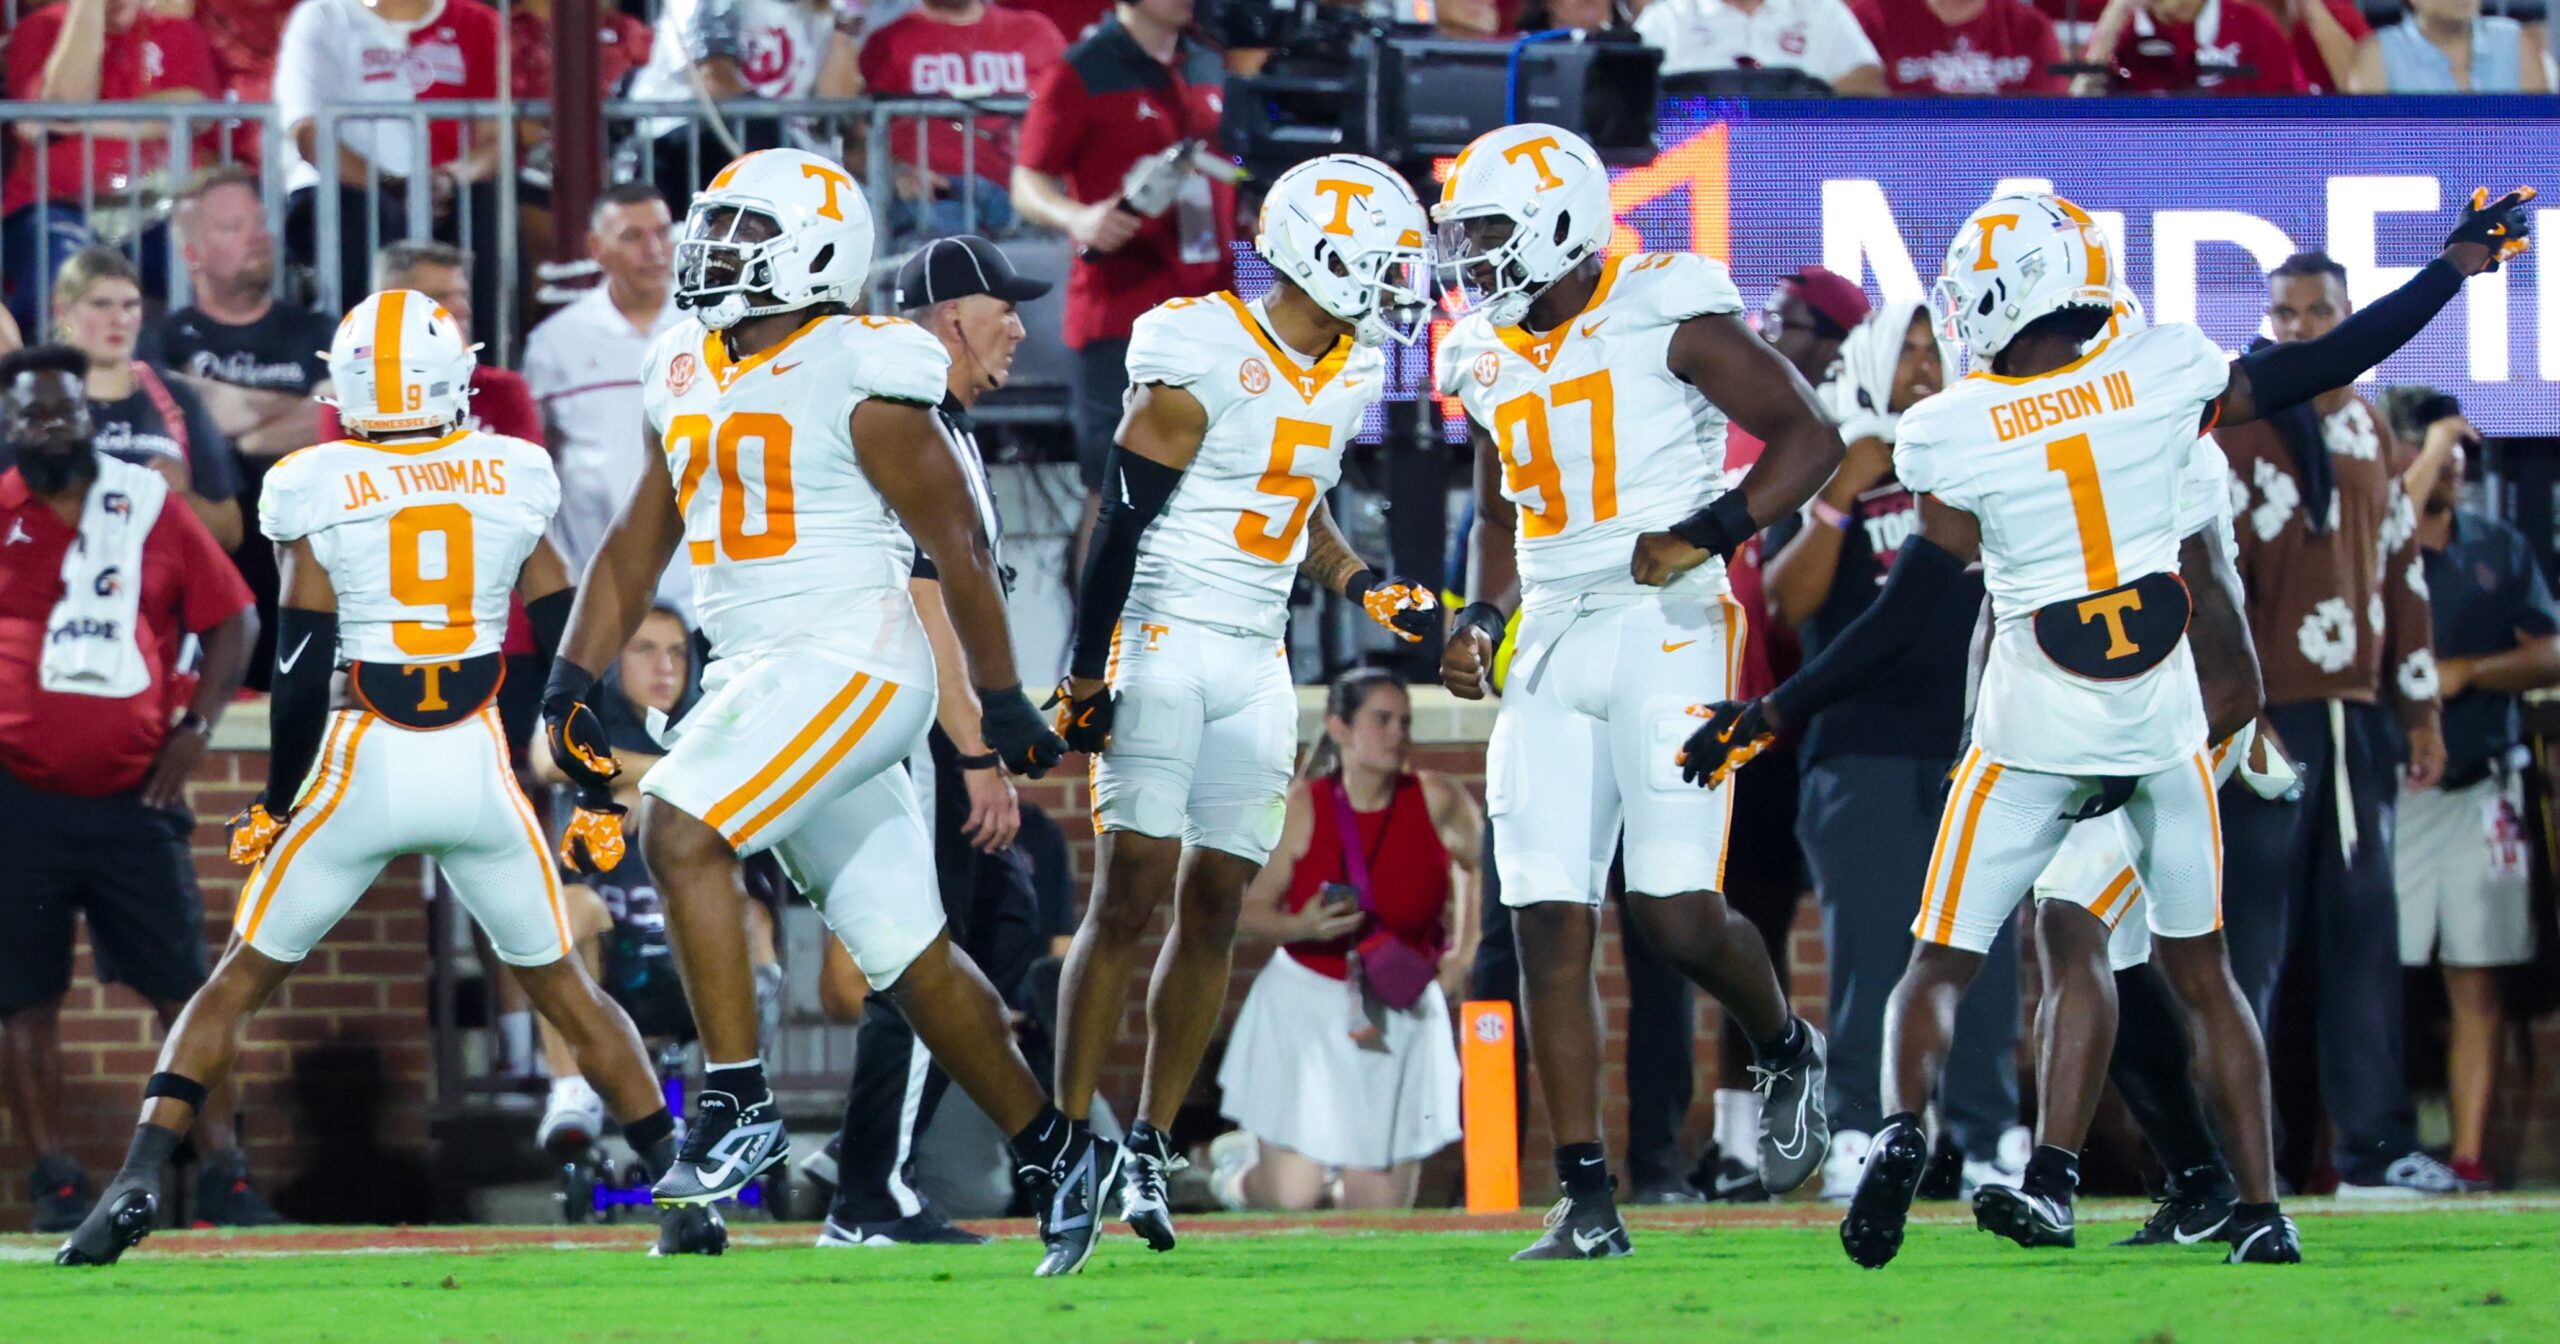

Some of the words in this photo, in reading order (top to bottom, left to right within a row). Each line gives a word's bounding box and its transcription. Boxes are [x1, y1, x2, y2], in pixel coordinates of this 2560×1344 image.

[800, 164, 852, 221] T
[1502, 137, 1564, 192] T
[1315, 179, 1374, 236] T
[1973, 214, 2019, 271] T
[720, 366, 739, 386] T
[1532, 343, 1552, 366] T
[407, 384, 421, 411] 9
[1298, 375, 1316, 397] T
[1989, 380, 2103, 442] GIBSON
[2103, 370, 2135, 411] III
[1494, 369, 1618, 539] 97
[344, 470, 389, 511] JA.
[388, 458, 505, 495] THOMAS
[665, 412, 797, 566] 20
[1233, 416, 1332, 564] 5
[2045, 432, 2119, 592] 1
[388, 502, 477, 656] 9
[1140, 623, 1170, 651] T
[2076, 588, 2142, 660] T
[403, 660, 461, 712] T
